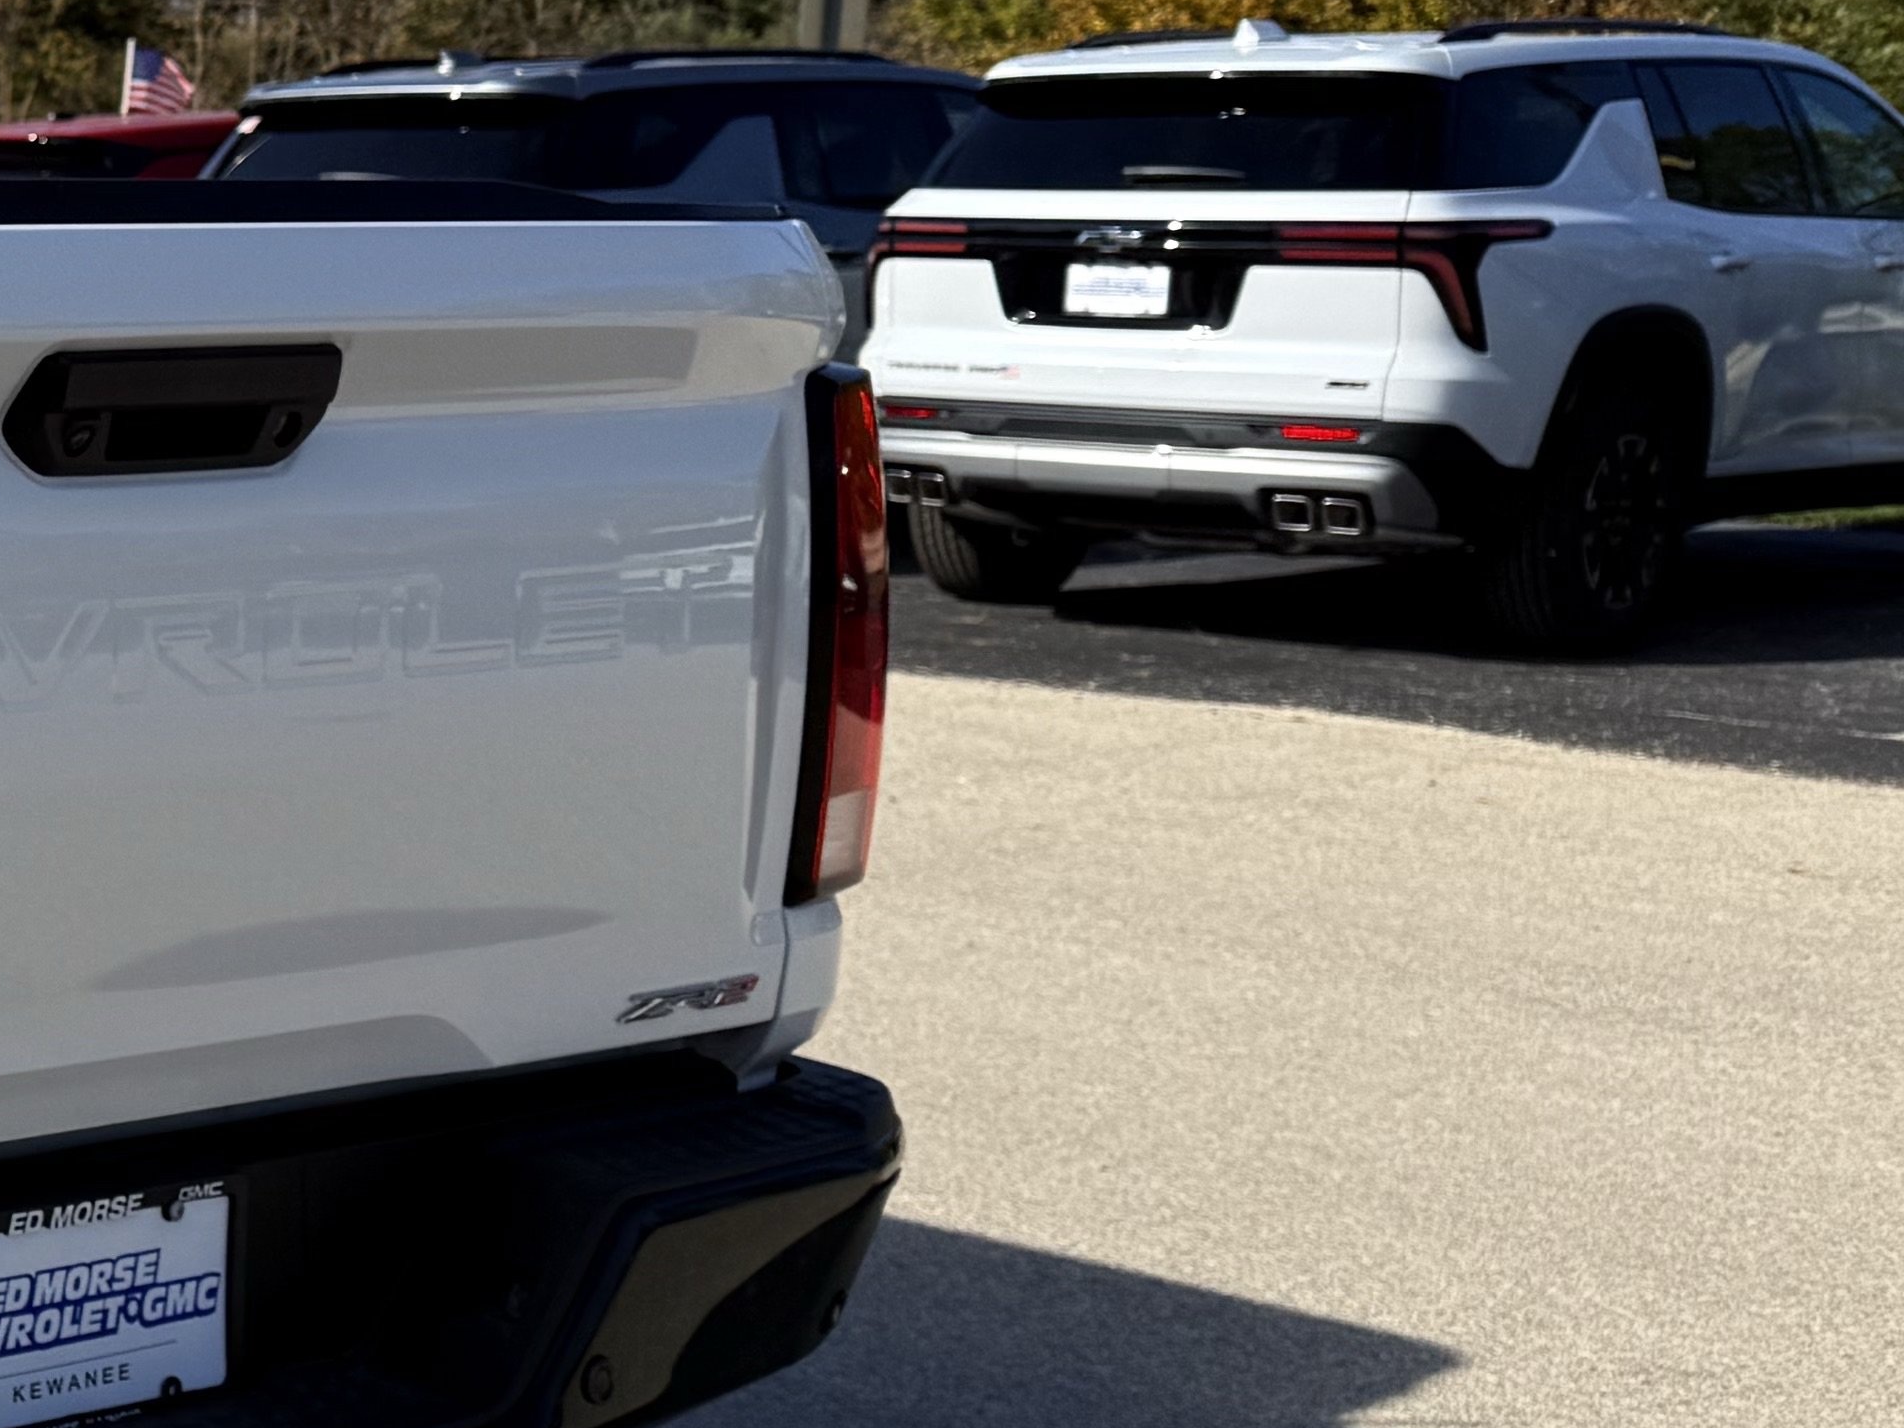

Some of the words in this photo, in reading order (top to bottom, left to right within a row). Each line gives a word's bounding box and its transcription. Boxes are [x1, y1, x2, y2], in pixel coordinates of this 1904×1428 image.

[8, 1210, 44, 1236] ED
[50, 1193, 143, 1230] MORSE
[33, 1249, 160, 1305] MORSE
[12, 1362, 132, 1403] KEWANEE
